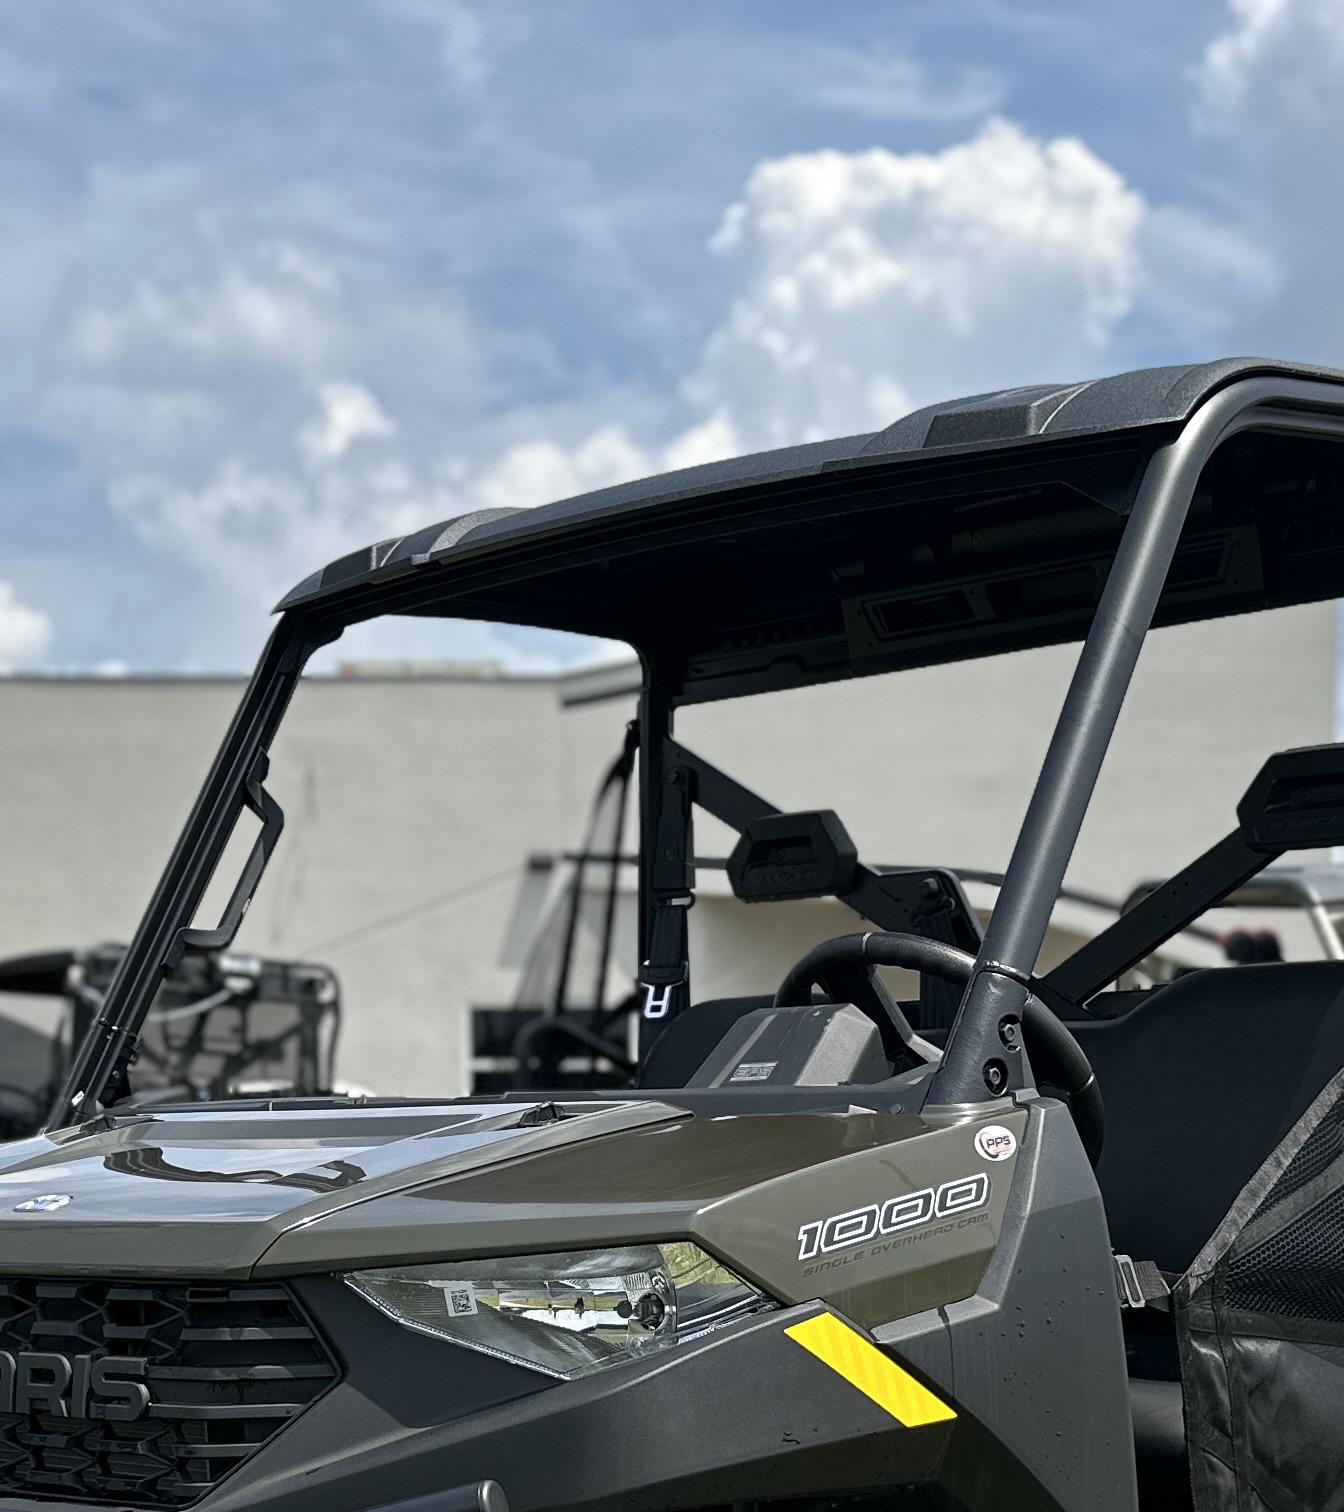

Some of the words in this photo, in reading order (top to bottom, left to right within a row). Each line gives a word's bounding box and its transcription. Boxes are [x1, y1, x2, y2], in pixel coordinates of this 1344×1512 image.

[797, 1172, 991, 1262] 1000
[802, 1251, 865, 1278] SINGLE
[870, 1224, 954, 1256] OVERHEAD
[956, 1212, 990, 1230] CAM
